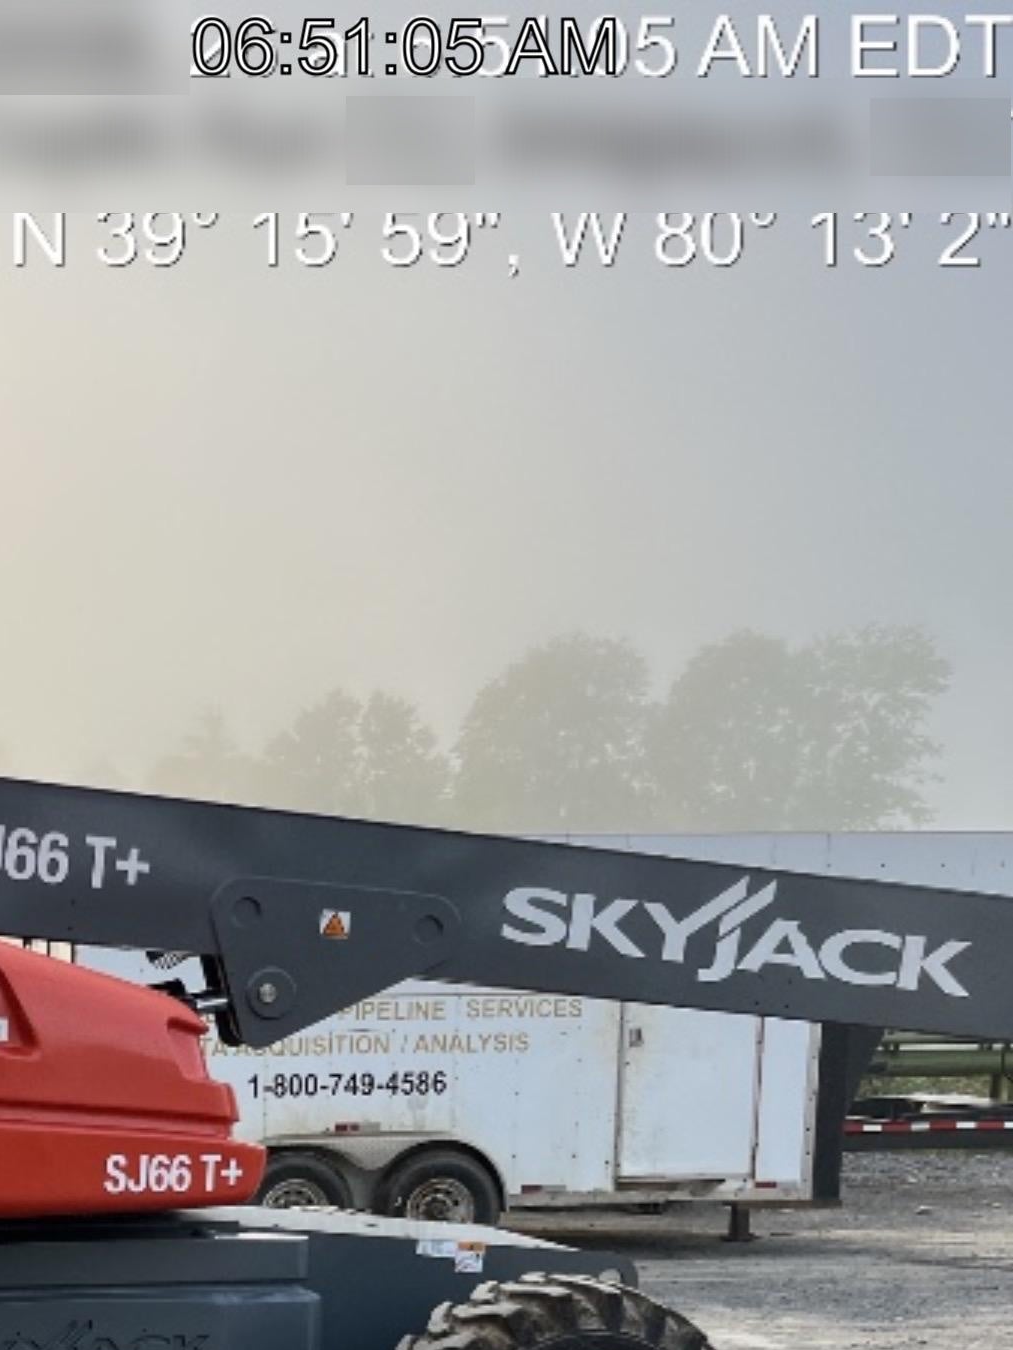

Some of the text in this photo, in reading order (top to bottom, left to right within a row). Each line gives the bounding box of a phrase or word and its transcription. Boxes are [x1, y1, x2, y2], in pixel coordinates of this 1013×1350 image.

[86, 834, 150, 889] T+
[501, 874, 973, 997] SKYJACK
[466, 998, 583, 1019] SERVICES
[413, 1033, 530, 1054] ANALYSIS
[247, 1070, 448, 1099] 1-800-749-4586
[104, 1153, 244, 1194] SJ66 T+
